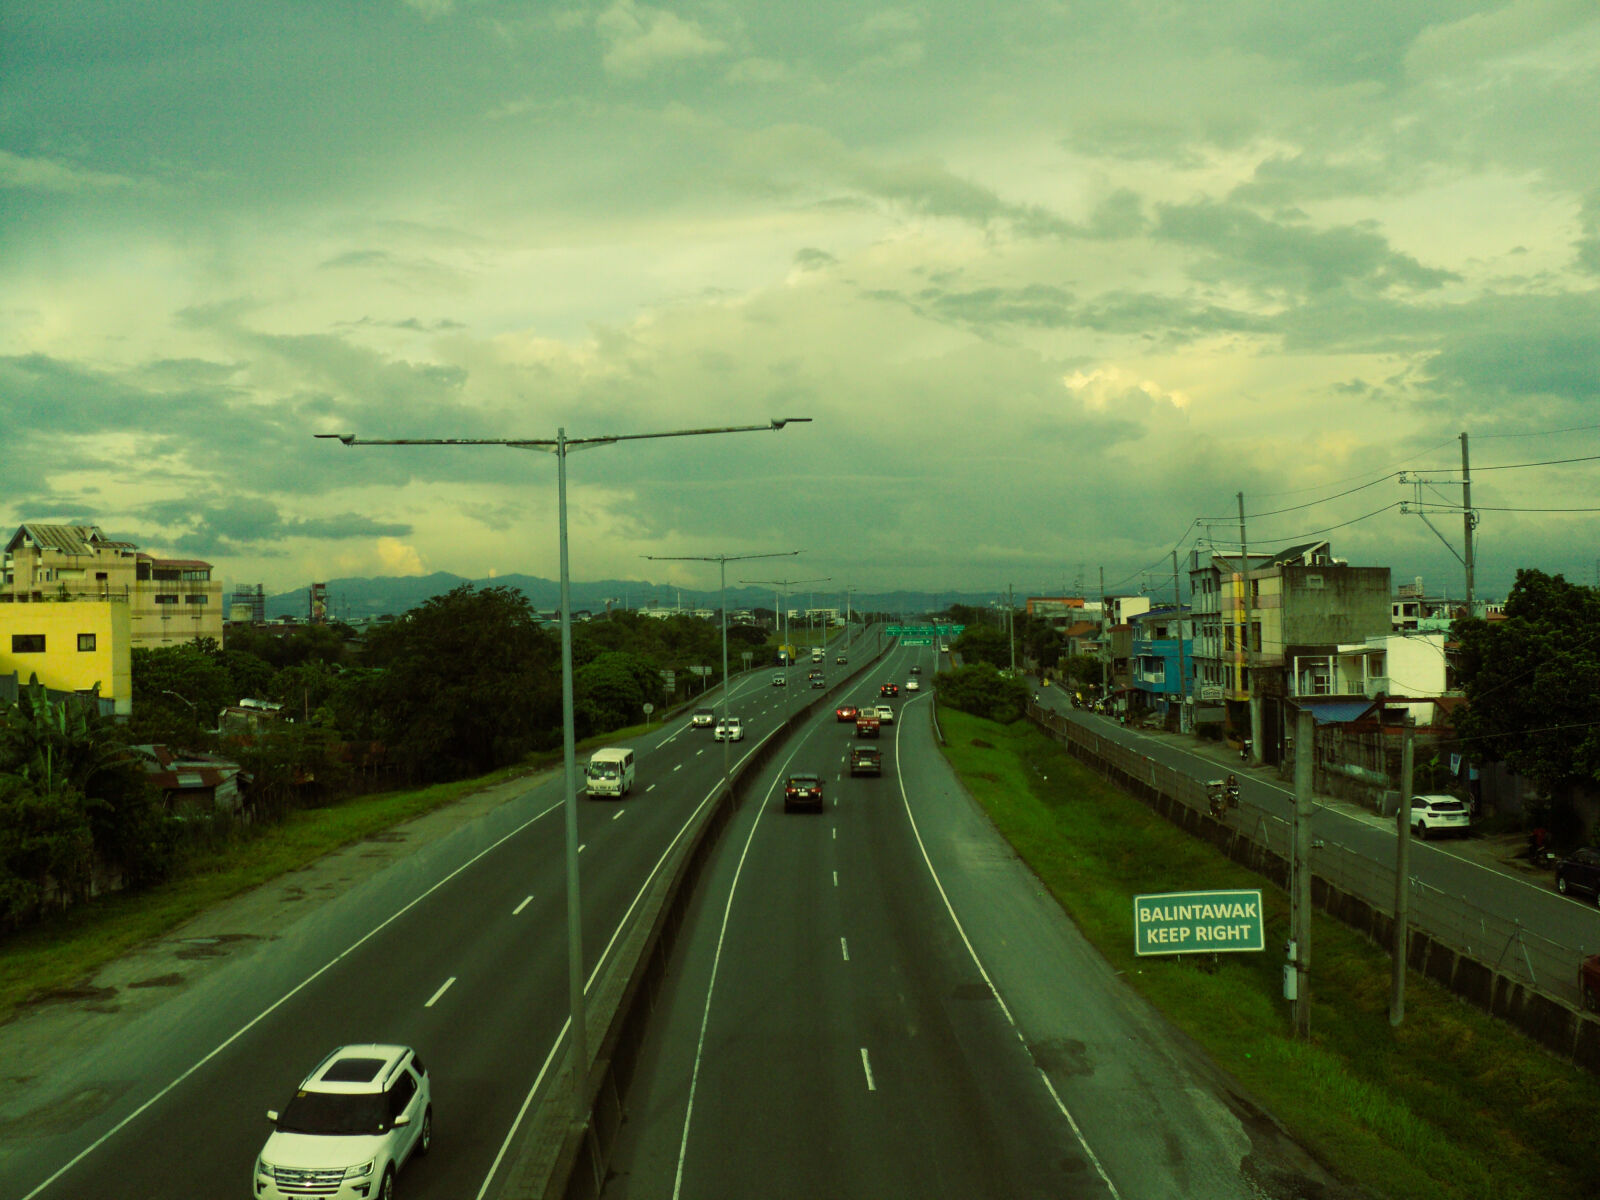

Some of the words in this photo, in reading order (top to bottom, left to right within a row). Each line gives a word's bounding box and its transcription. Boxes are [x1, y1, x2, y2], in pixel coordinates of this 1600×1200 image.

[1140, 903, 1257, 922] BALINTAWAK
[1147, 927, 1191, 944] KEEP
[1195, 925, 1251, 941] RIGHT
